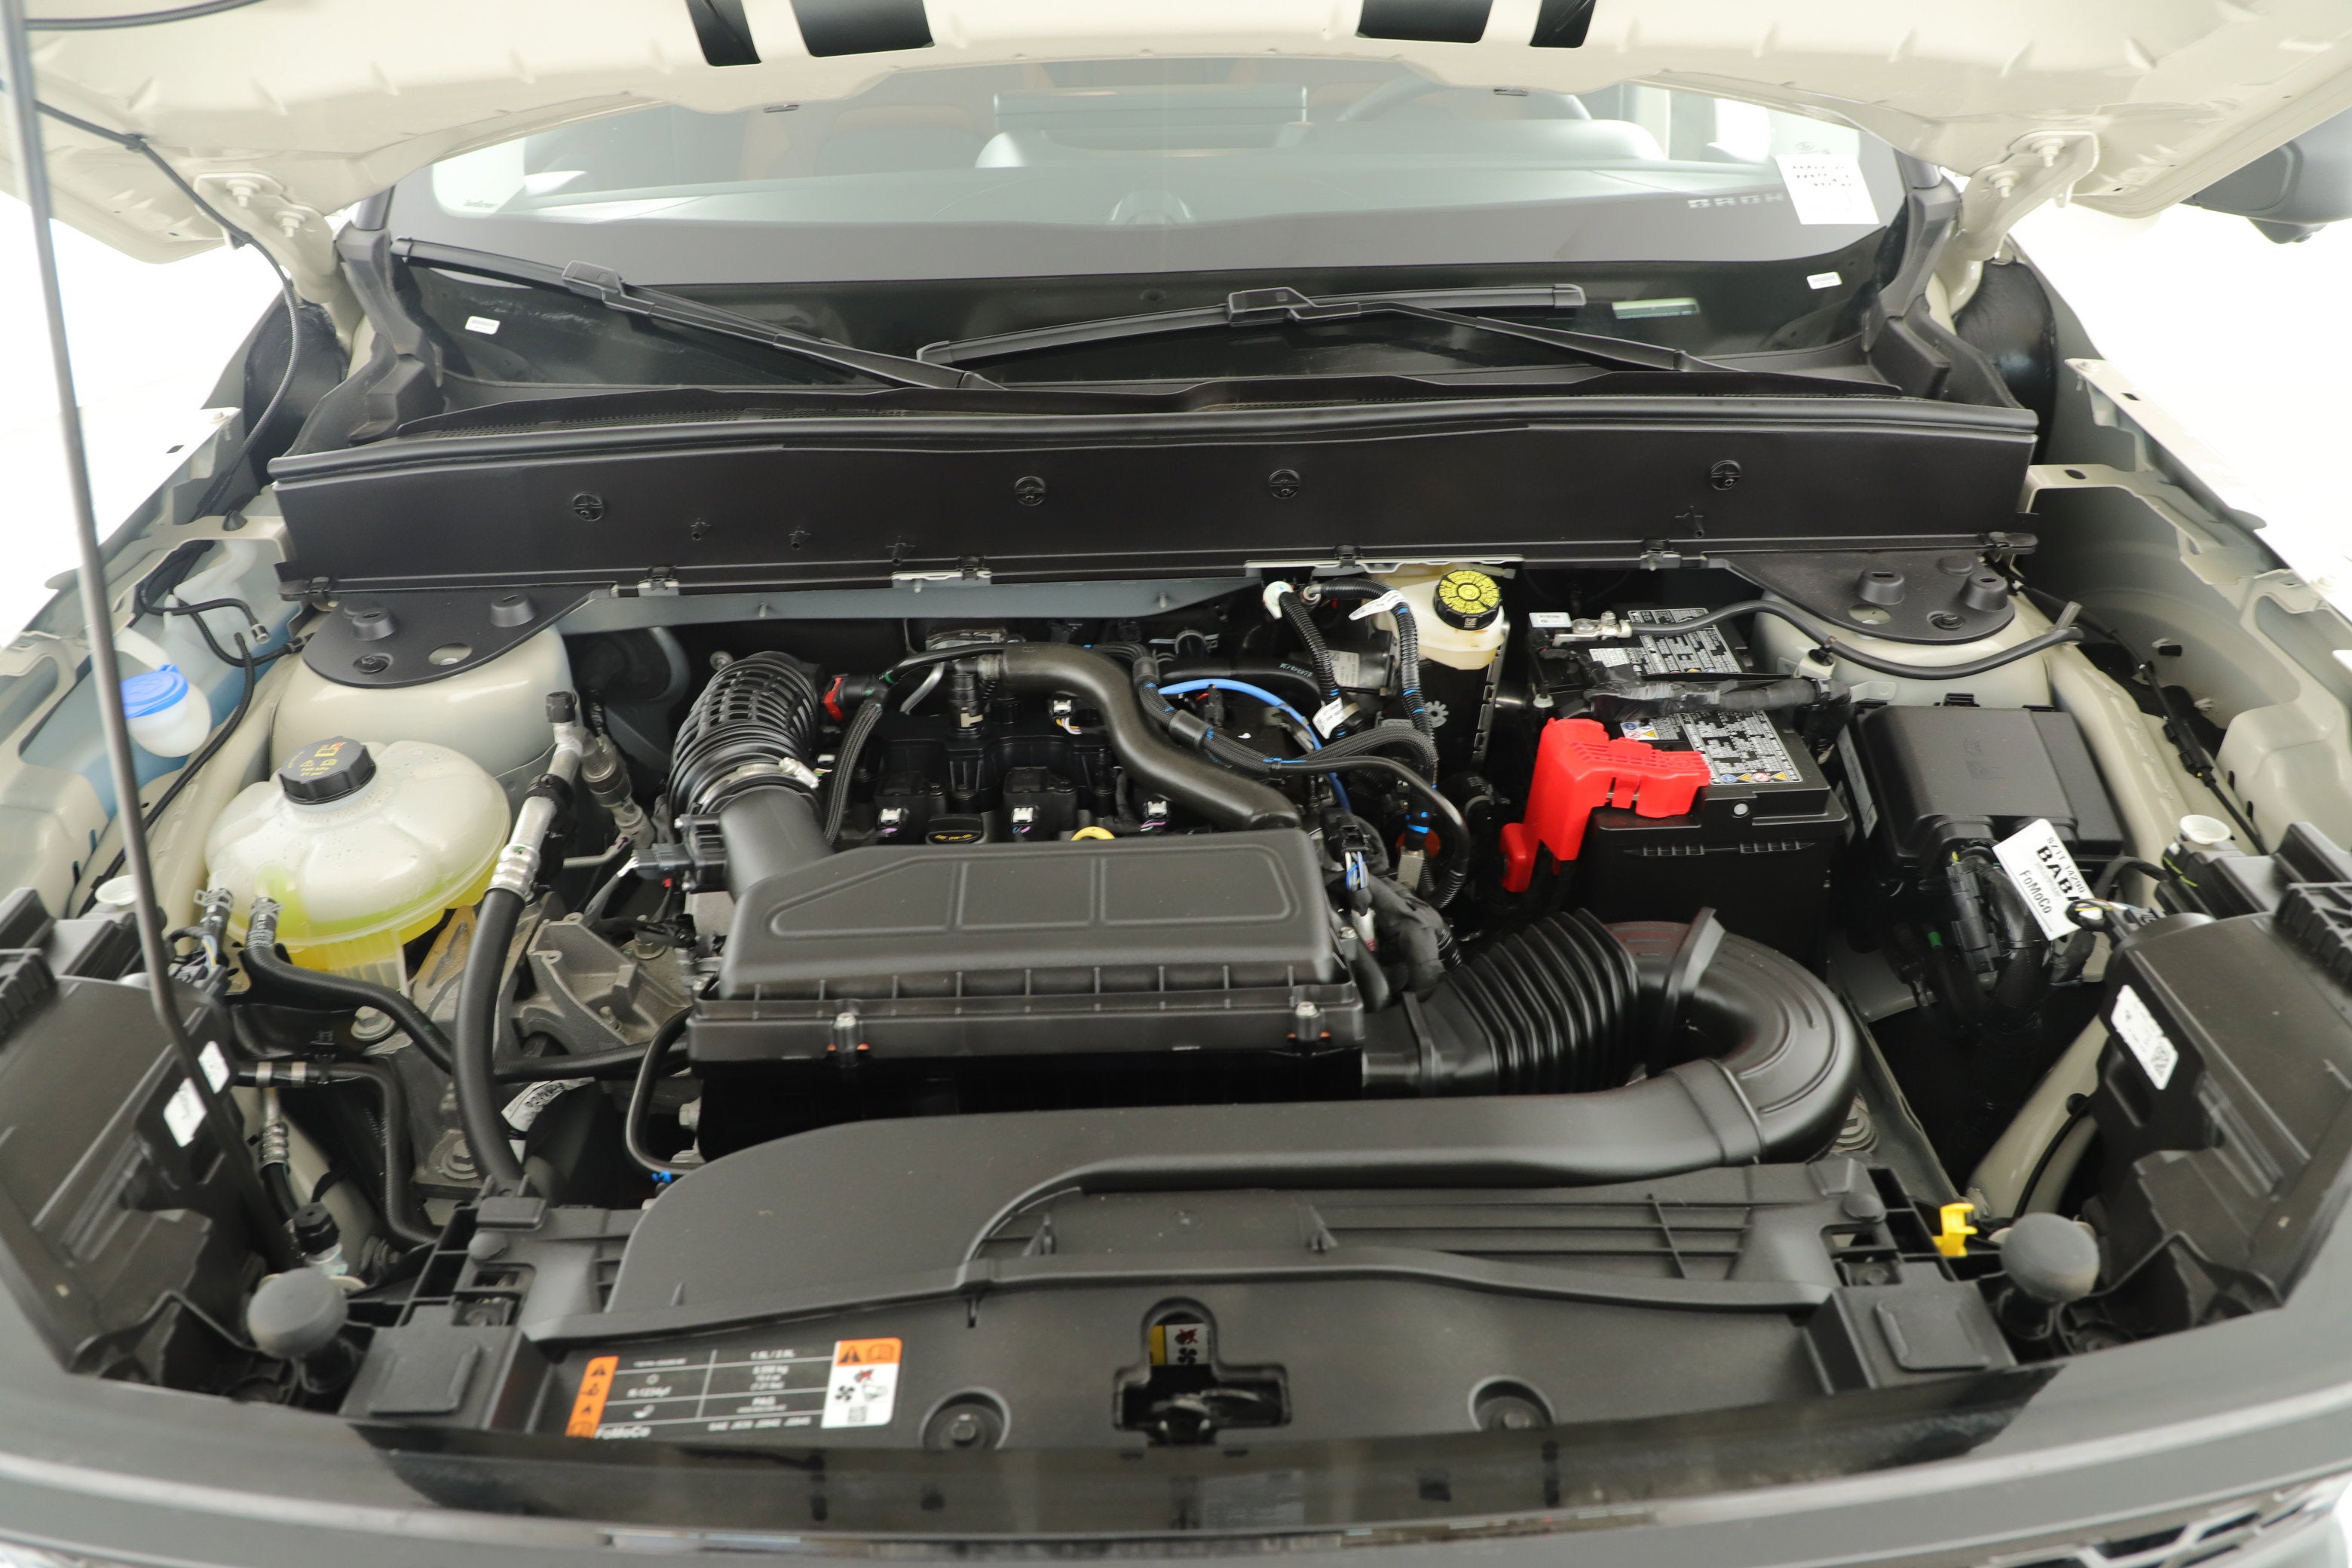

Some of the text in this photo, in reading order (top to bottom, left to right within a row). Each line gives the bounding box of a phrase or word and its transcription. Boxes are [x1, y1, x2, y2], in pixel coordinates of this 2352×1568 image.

[1687, 192, 1784, 209] BRON
[2019, 869, 2052, 914] FoMoCo
[595, 1426, 652, 1441] FoMoCo
